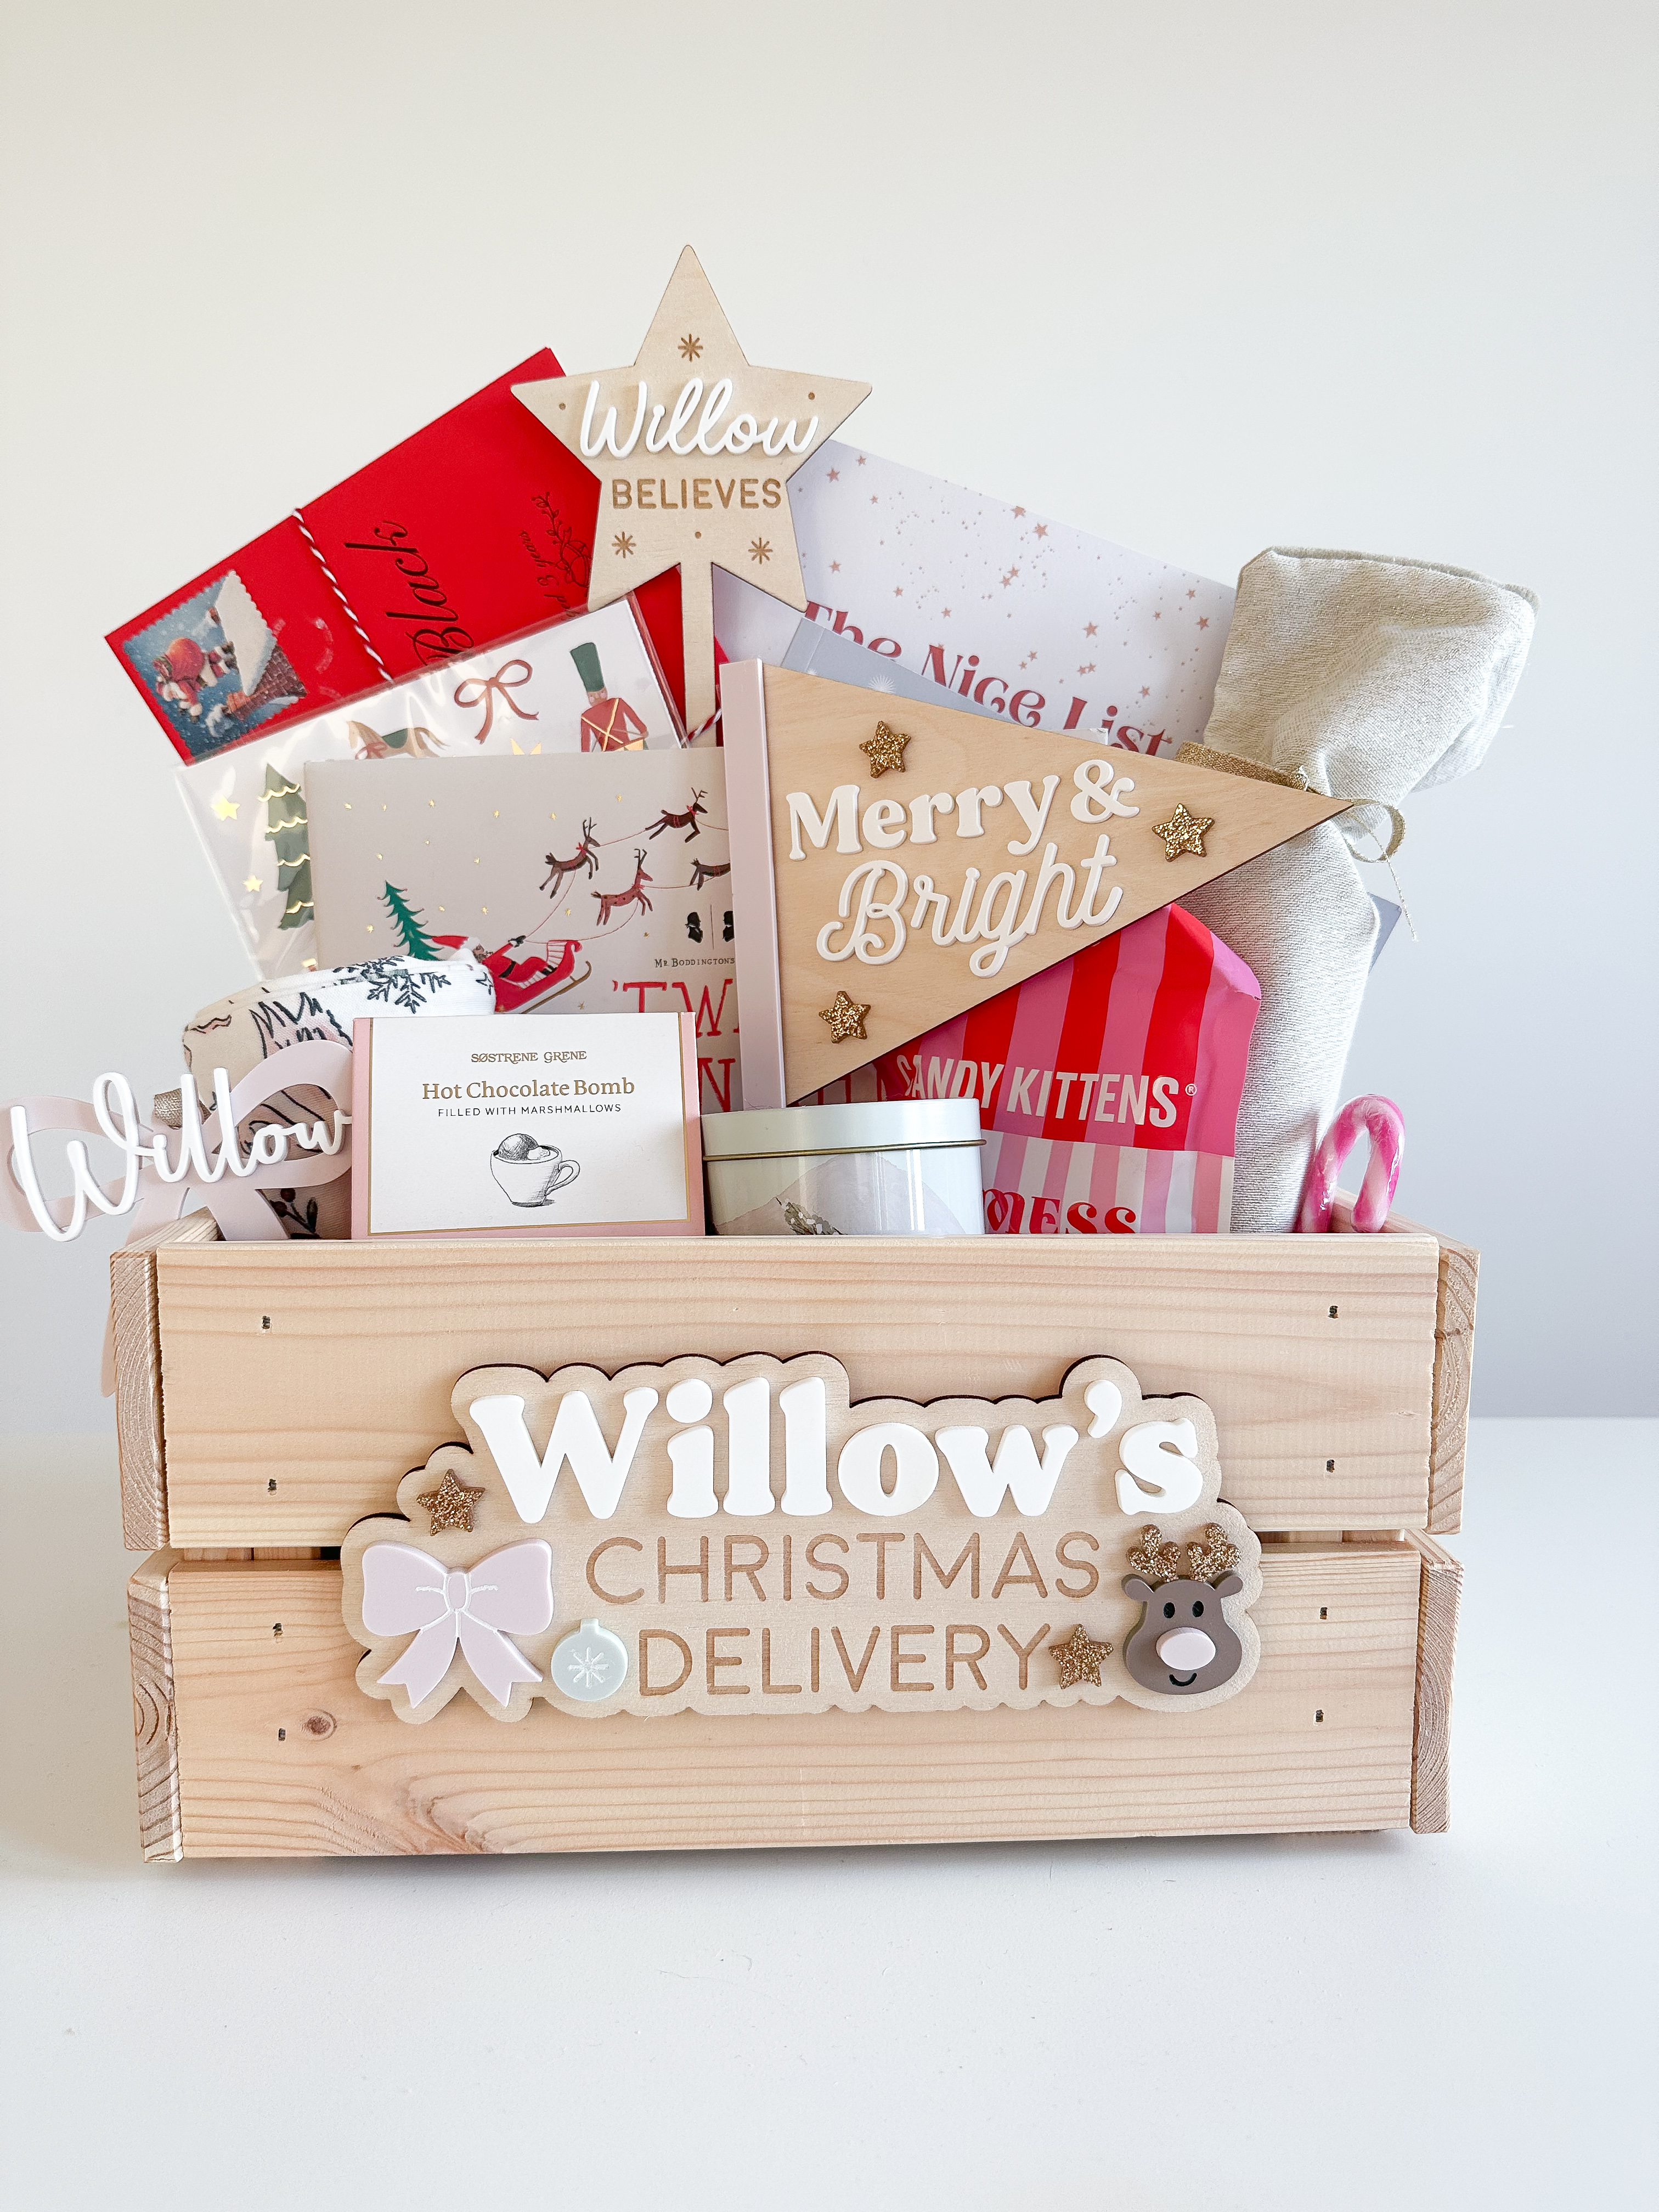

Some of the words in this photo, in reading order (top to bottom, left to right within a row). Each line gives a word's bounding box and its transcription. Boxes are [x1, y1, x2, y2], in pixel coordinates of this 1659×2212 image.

[580, 377, 819, 459] Willow
[612, 478, 781, 509] BELIEVES
[518, 530, 556, 567] years
[922, 645, 1045, 728] Nice
[786, 775, 1060, 861] Merry
[1070, 759, 1140, 824] &
[816, 834, 1123, 978] Bright
[422, 1084, 462, 1099] Hot
[466, 1080, 569, 1098] Chocolate
[574, 1077, 635, 1096] Bomb
[471, 1052, 538, 1064] SØSTRENE
[544, 1051, 588, 1063] GRENE
[438, 1108, 481, 1117] FILLED
[485, 1106, 516, 1115] WITH
[521, 1104, 621, 1115] MARSHMALLOWS
[10, 1066, 352, 1242] Willow
[469, 1375, 1203, 1524] Willow's
[585, 1531, 1100, 1604] CHRISTMAS
[639, 1623, 1051, 1696] DELIVERY
